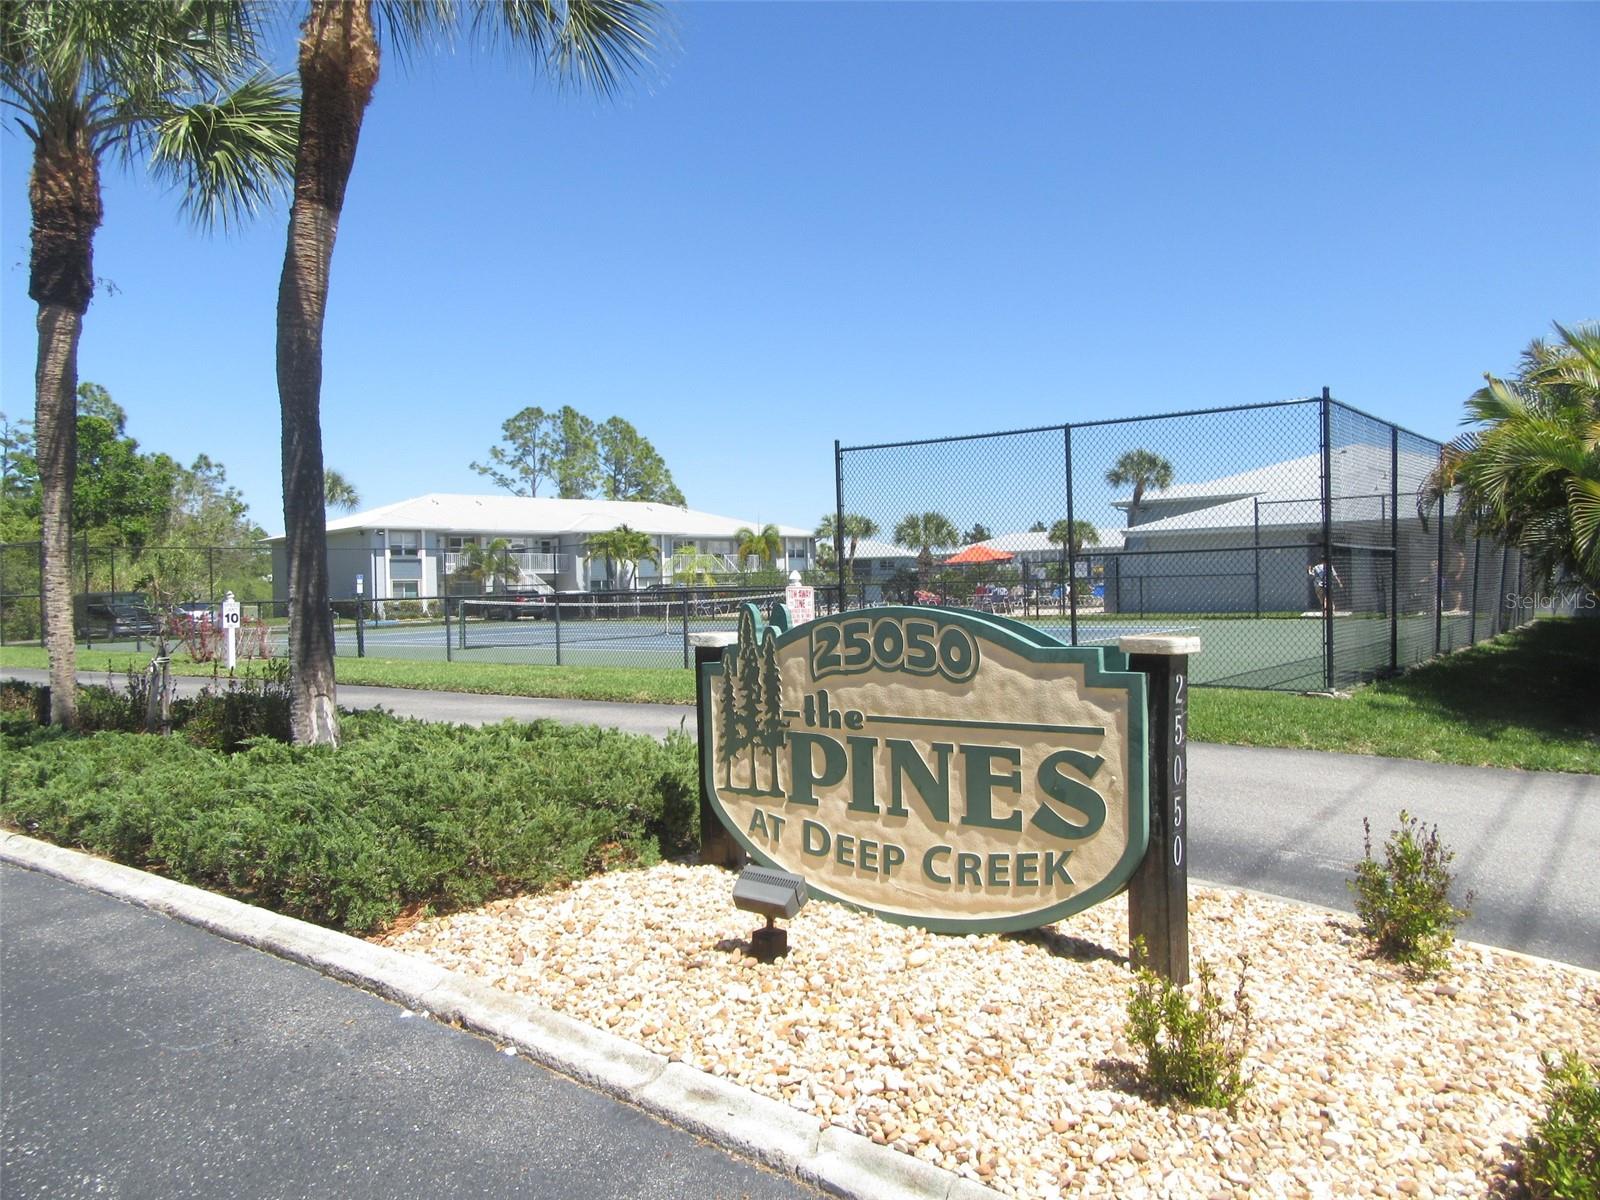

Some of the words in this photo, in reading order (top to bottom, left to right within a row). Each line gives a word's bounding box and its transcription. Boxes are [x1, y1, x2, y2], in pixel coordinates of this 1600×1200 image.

[225, 613, 239, 624] 10
[811, 617, 978, 681] 25050
[804, 690, 864, 730] the
[788, 731, 1107, 840] PINES
[1173, 674, 1183, 866] 25050
[750, 808, 786, 844] AT
[803, 818, 905, 876] DEEP
[923, 845, 1075, 887] CREEK
